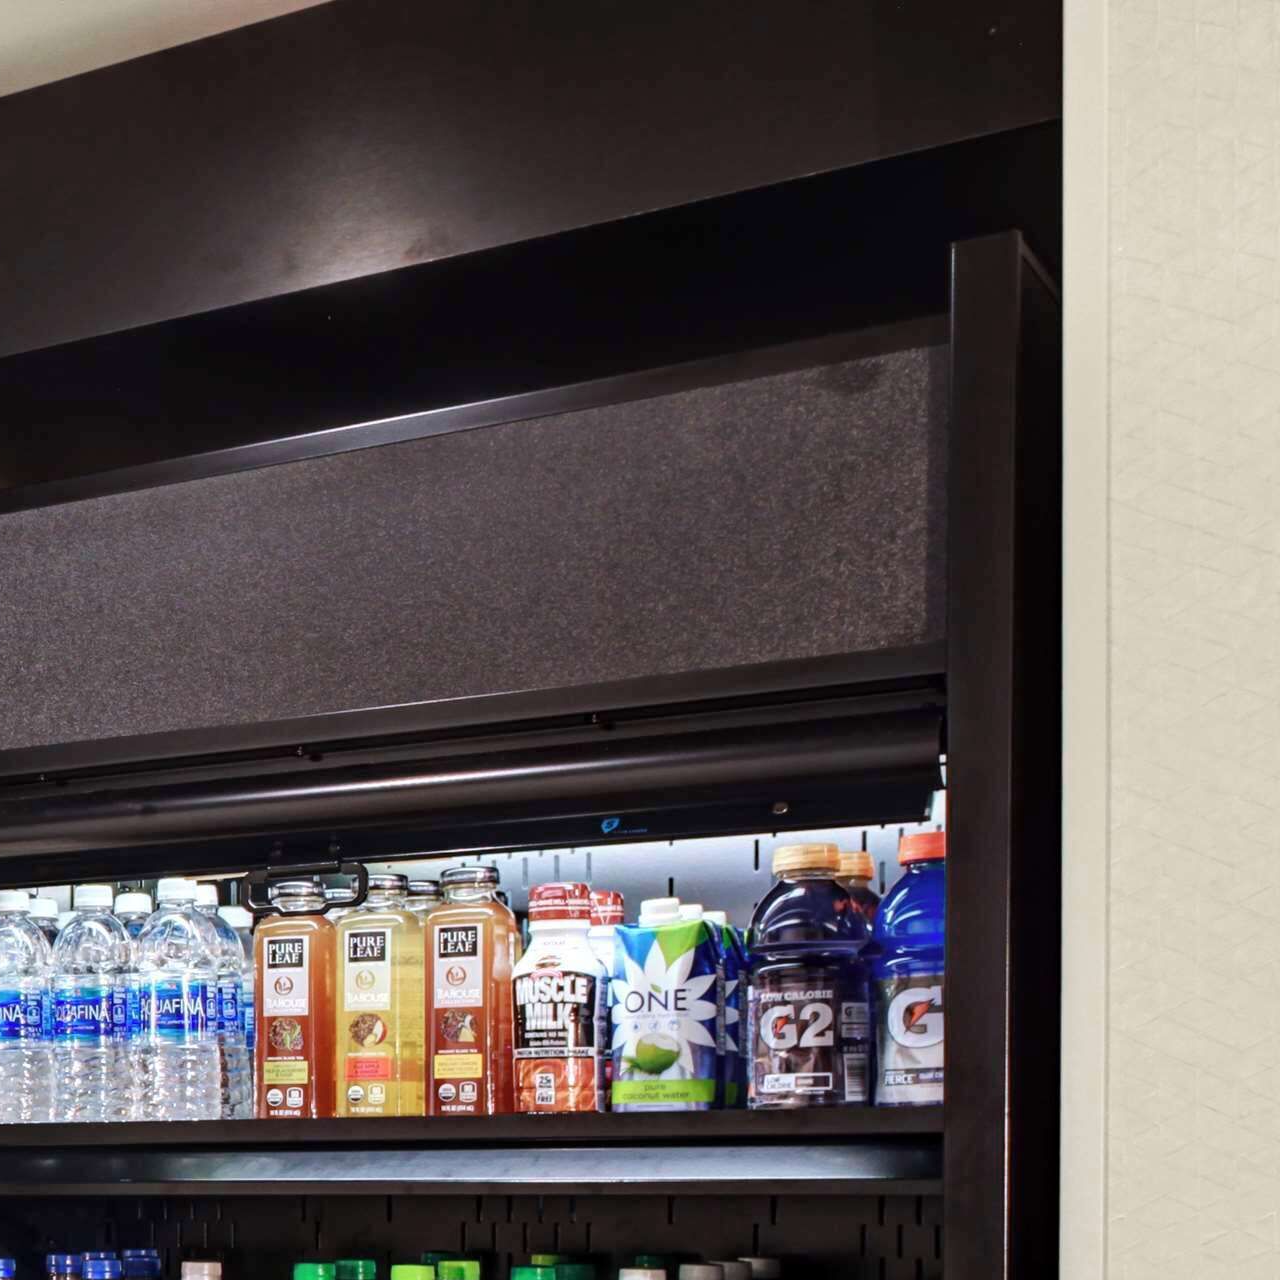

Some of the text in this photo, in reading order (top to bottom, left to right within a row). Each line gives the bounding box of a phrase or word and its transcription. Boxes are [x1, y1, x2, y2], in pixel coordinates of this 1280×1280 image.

[350, 935, 385, 948] PURE
[440, 930, 476, 943] PURE
[269, 942, 303, 954] PURE
[350, 946, 382, 958] LEAF
[440, 941, 473, 953] LEAF
[269, 953, 300, 965] LEAF
[515, 976, 588, 1004] MUSCLE
[761, 989, 833, 1002] LOW CALORIE
[625, 985, 687, 1014] ONE
[526, 1003, 573, 1031] MILK
[888, 985, 944, 1049] G
[760, 1002, 835, 1050] G2
[884, 1073, 914, 1086] FIERCE
[623, 1090, 690, 1101] coconut water
[644, 1083, 667, 1095] pure
